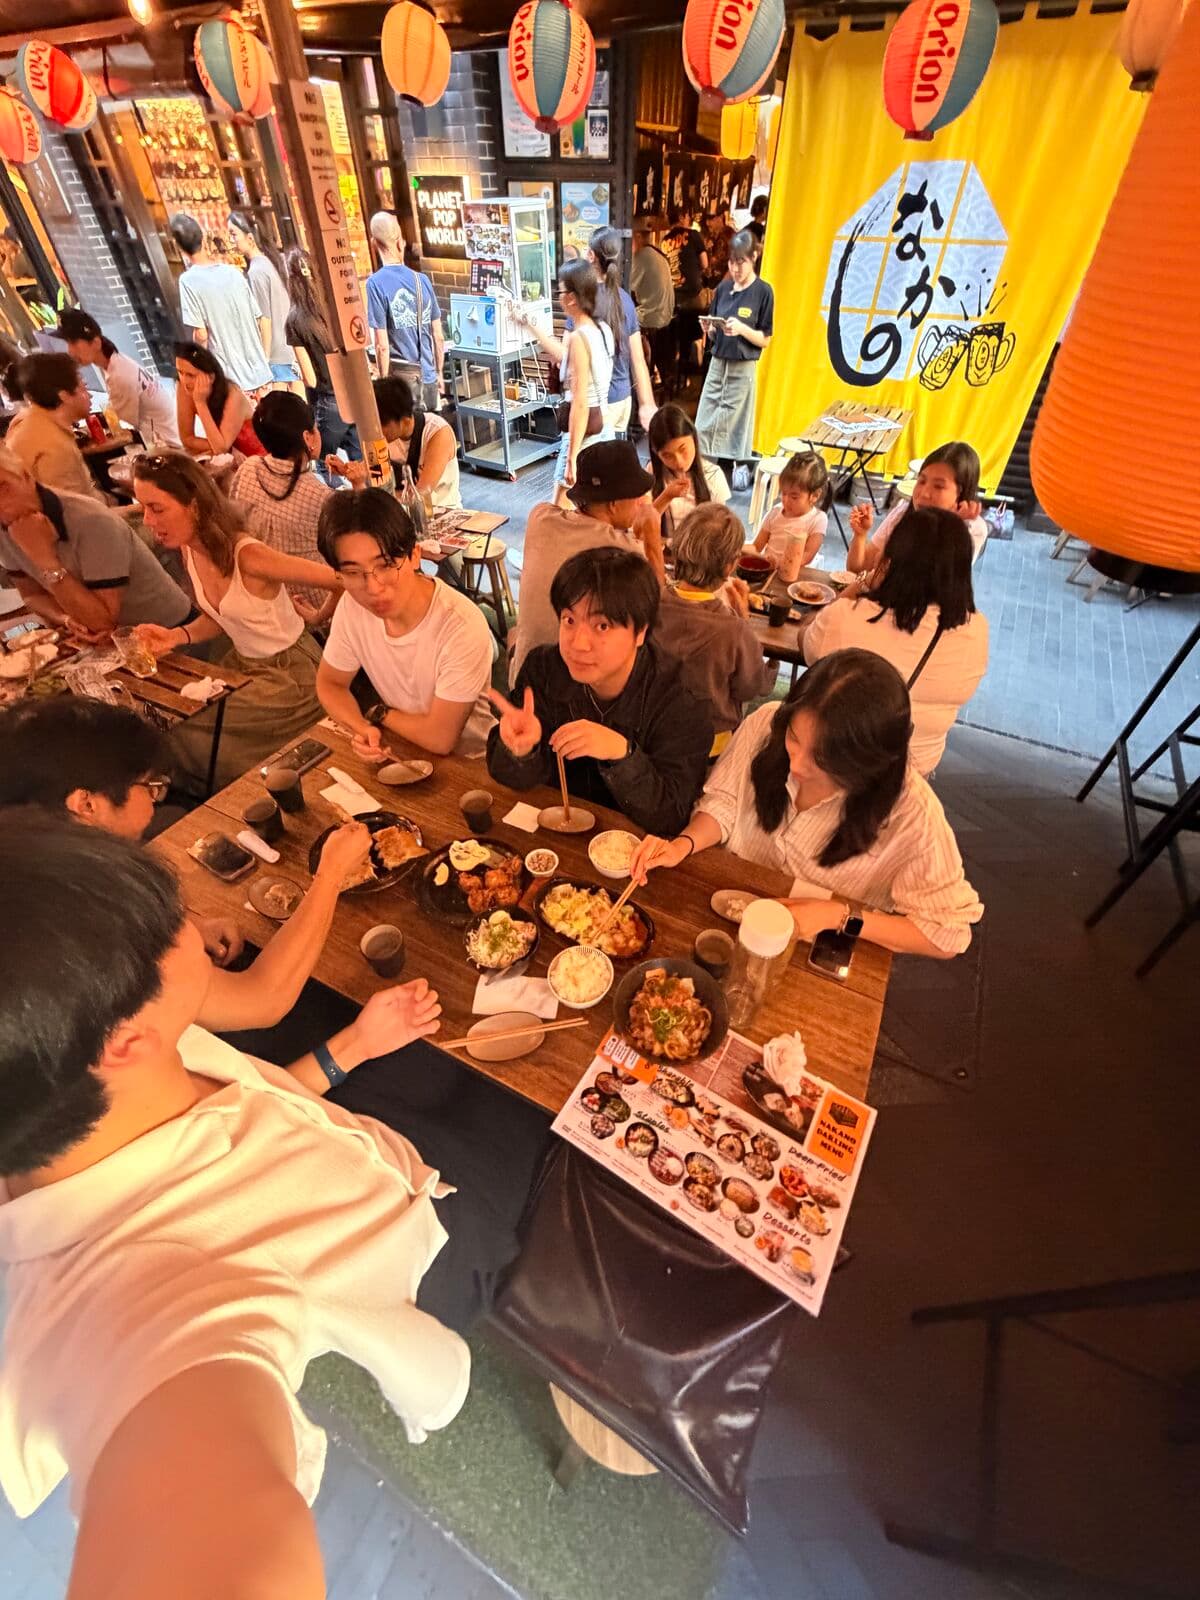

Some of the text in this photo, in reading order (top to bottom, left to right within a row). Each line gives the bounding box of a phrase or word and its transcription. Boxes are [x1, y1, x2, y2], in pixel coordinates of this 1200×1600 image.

[514, 4, 533, 82] Orion
[914, 3, 960, 103] Orion
[417, 191, 461, 209] PLANET
[433, 210, 457, 226] POP
[425, 227, 466, 246] WORLD
[635, 1110, 671, 1134] Staples
[819, 1119, 857, 1145] NAKANO
[816, 1127, 855, 1155] DARLING
[819, 1140, 845, 1159] MENU
[763, 1211, 812, 1246] Desserts
